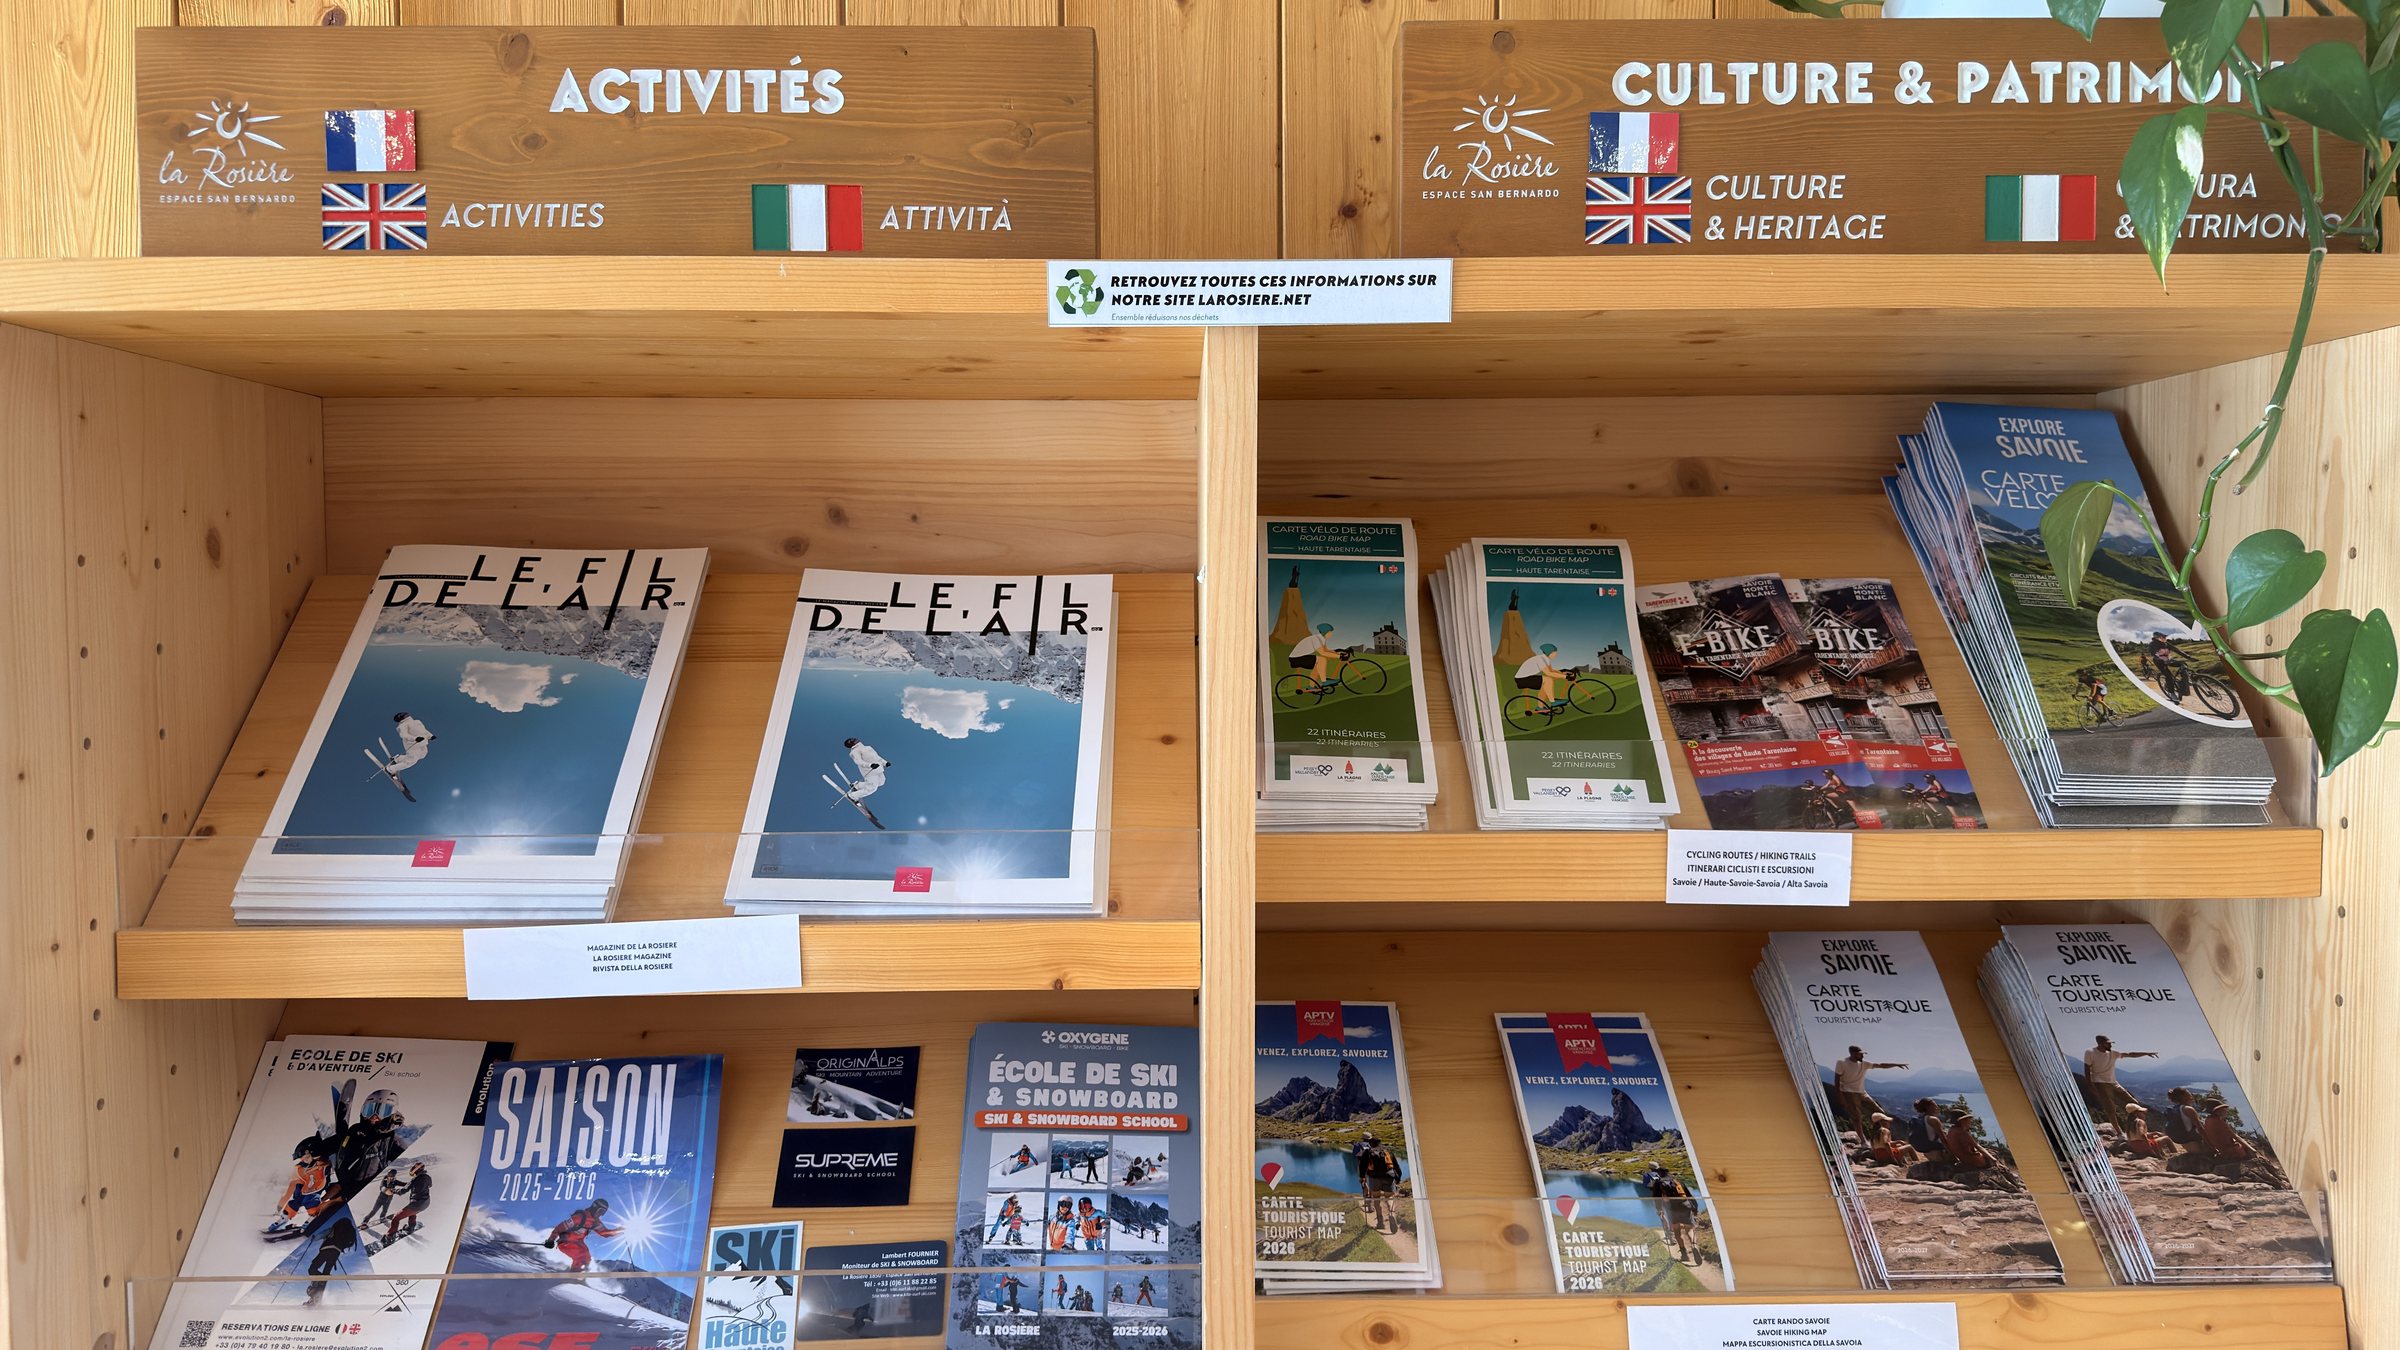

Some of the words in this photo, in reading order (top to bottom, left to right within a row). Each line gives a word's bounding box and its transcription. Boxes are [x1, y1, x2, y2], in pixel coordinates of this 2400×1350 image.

[549, 55, 845, 114] ACTIVITÉS
[1611, 61, 1874, 106] CULTURE
[1895, 60, 1934, 105] &
[159, 150, 188, 184] la
[192, 146, 295, 190] Rosière
[1423, 145, 1453, 180] la
[1457, 140, 1560, 186] Rosière
[1422, 190, 1466, 199] ESPACE
[1470, 190, 1493, 199] SAN
[1498, 189, 1560, 198] BERNARDO
[1705, 174, 1846, 200] CULTURE
[159, 194, 203, 203] ESPACE
[207, 194, 230, 203] SAN
[234, 194, 296, 203] BERNARDO
[440, 202, 605, 229] ACTIVITIES
[880, 198, 1012, 231] ATTIVITÀ
[1704, 214, 1726, 240] &
[1734, 214, 1887, 240] HERITAGE
[2114, 213, 2135, 239] &
[1110, 275, 1197, 288] RETROUVEZ
[1201, 275, 1257, 288] TOUTES
[1259, 275, 1287, 288] CES
[1290, 274, 1405, 287] INFORMATIONS
[1408, 274, 1437, 287] SUR
[1111, 294, 1161, 306] NOTRE
[1164, 294, 1194, 306] SITE
[1198, 293, 1311, 306] LAROSIERE.NET
[1111, 313, 1144, 321] Ensemble
[1145, 313, 1178, 321] réduisons
[1192, 313, 1219, 321] déchets
[1998, 417, 2066, 436] EXPLORE
[1996, 435, 2088, 464] SAVOIE
[1981, 469, 2065, 493] CARTE
[1272, 525, 1308, 533] CARTE
[1309, 525, 1339, 534] VÉLO
[1341, 526, 1357, 534] DE
[1359, 526, 1397, 535] ROUTE
[469, 554, 542, 583] LE
[383, 580, 468, 608] DE
[889, 581, 955, 608] LE
[1745, 590, 1777, 598] BLANC
[809, 604, 888, 634] DE
[1675, 625, 1776, 656] E-BIKE
[1307, 728, 1319, 736] 22
[1321, 728, 1387, 739] ITINÉRAIRES
[1541, 751, 1554, 759] 22
[1556, 751, 1623, 760] ITINÉRAIRES
[1563, 761, 1616, 769] ITINERARIES
[1686, 850, 1721, 859] CYCLING
[1722, 851, 1753, 860] ROUTES
[1754, 851, 1759, 860] /
[1760, 852, 1789, 860] HIKING
[1790, 852, 1816, 861] TRAILS
[1687, 864, 1726, 873] ITINERARI
[1727, 865, 1760, 873] CICLISTI
[1761, 866, 1766, 874] E
[1767, 866, 1814, 874] ESCURSIONI
[1672, 878, 1697, 886] Savoie
[1697, 878, 1702, 887] /
[1703, 878, 1781, 888] Haute-Savoie-Savoia
[1781, 879, 1786, 888] /
[1787, 879, 1802, 888] Alta
[1803, 880, 1828, 889] Savoia
[2055, 931, 2114, 943] EXPLORE
[1821, 939, 1878, 951] EXPLORE
[2057, 944, 2137, 965] SAVOIE
[1820, 954, 1898, 975] SAVOIE
[2047, 975, 2104, 987] CARTE
[1806, 984, 1862, 997] CARTE
[1304, 1011, 1336, 1020] APTV
[2059, 1006, 2105, 1014] TOURISTIC
[2106, 1005, 2127, 1013] MAP
[1816, 1016, 1862, 1024] TOURISTIC
[1863, 1016, 1882, 1024] MAP
[1058, 1031, 1129, 1045] OXYGENE
[1564, 1039, 1596, 1048] APTV
[290, 1049, 346, 1062] ECOLE
[349, 1050, 372, 1062] DE
[375, 1051, 403, 1064] SKI
[1257, 1047, 1289, 1057] VENEZ,
[1291, 1048, 1340, 1058] EXPLOREZ,
[1342, 1049, 1388, 1058] SAVOUREZ
[287, 1063, 294, 1071] &
[297, 1063, 372, 1073] D'AVENTURE
[397, 1070, 421, 1078] school
[989, 1053, 1077, 1084] ÉCOLE
[1086, 1062, 1121, 1085] DE
[1130, 1063, 1178, 1087] SKI
[1525, 1076, 1558, 1085] VENEZ,
[1560, 1077, 1610, 1086] EXPLOREZ,
[1612, 1077, 1659, 1086] SAVOUREZ
[475, 1063, 495, 1114] evolution
[986, 1086, 1004, 1106] &
[1015, 1087, 1178, 1109] SNOWBOARD
[490, 1063, 678, 1171] SAISON
[984, 1113, 1008, 1125] SKI
[1012, 1112, 1023, 1124] &
[1027, 1113, 1118, 1126] SNOWBOARD
[1122, 1116, 1178, 1128] SCHOOL
[794, 1152, 899, 1171] SUPREME
[499, 1172, 598, 1201] 2025-2026
[1261, 1196, 1304, 1209] CARTE
[1262, 1211, 1346, 1224] TOURISTIQUE
[1263, 1225, 1313, 1239] TOURIST
[1317, 1226, 1342, 1239] MAP
[1562, 1231, 1606, 1244] CARTE
[908, 1250, 939, 1258] FOURNIER
[1262, 1241, 1296, 1255] 2026
[1565, 1244, 1650, 1258] TOURISTIQUE
[841, 1262, 871, 1270] Moniteur
[897, 1259, 939, 1267] SNOWBOARD
[1567, 1260, 1618, 1274] TOURIST
[1623, 1260, 1648, 1273] MAP
[1570, 1276, 1604, 1290] 2026
[221, 1323, 290, 1332] RESERVATIONS
[291, 1324, 301, 1332] EN
[304, 1325, 331, 1333] LIGNE
[1805, 1317, 1830, 1325] SAVOIE
[705, 1318, 787, 1349] Haute
[975, 1325, 990, 1335] LA
[994, 1323, 1040, 1336] ROSIÈRE
[1112, 1326, 1169, 1336] 2025-2026
[1722, 1340, 1747, 1348] MAPPA
[1813, 1339, 1835, 1347] DELLA
